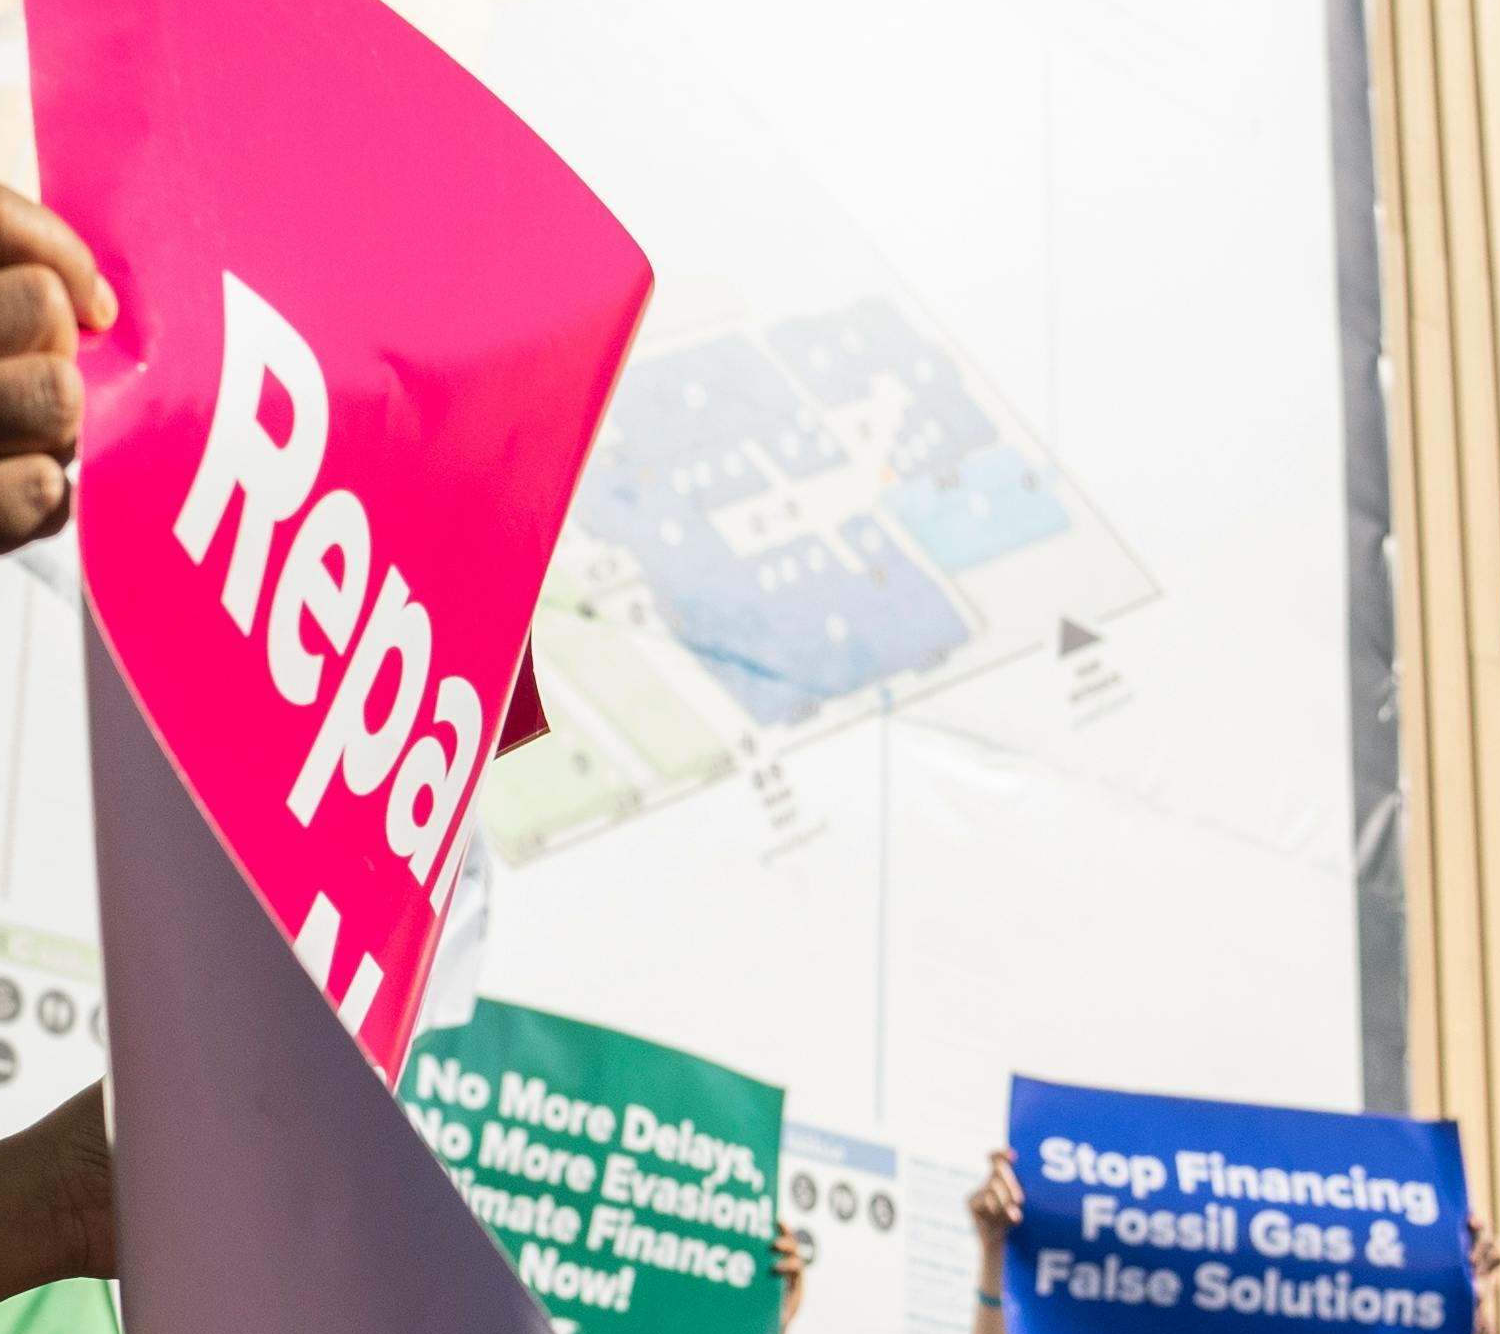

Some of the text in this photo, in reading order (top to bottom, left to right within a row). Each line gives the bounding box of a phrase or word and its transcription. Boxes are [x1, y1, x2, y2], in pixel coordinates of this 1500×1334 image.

[416, 1054, 492, 1111] No
[498, 1071, 617, 1144] More
[621, 1102, 766, 1193] Delays,
[478, 1121, 597, 1194] More
[601, 1154, 776, 1241] Evasion!
[1038, 1135, 1441, 1228] Stop Financing
[586, 1204, 757, 1289] Finance
[1081, 1193, 1407, 1269] Fossil Gas &
[518, 1242, 637, 1314] Now!
[1035, 1249, 1447, 1332] False Solutions
